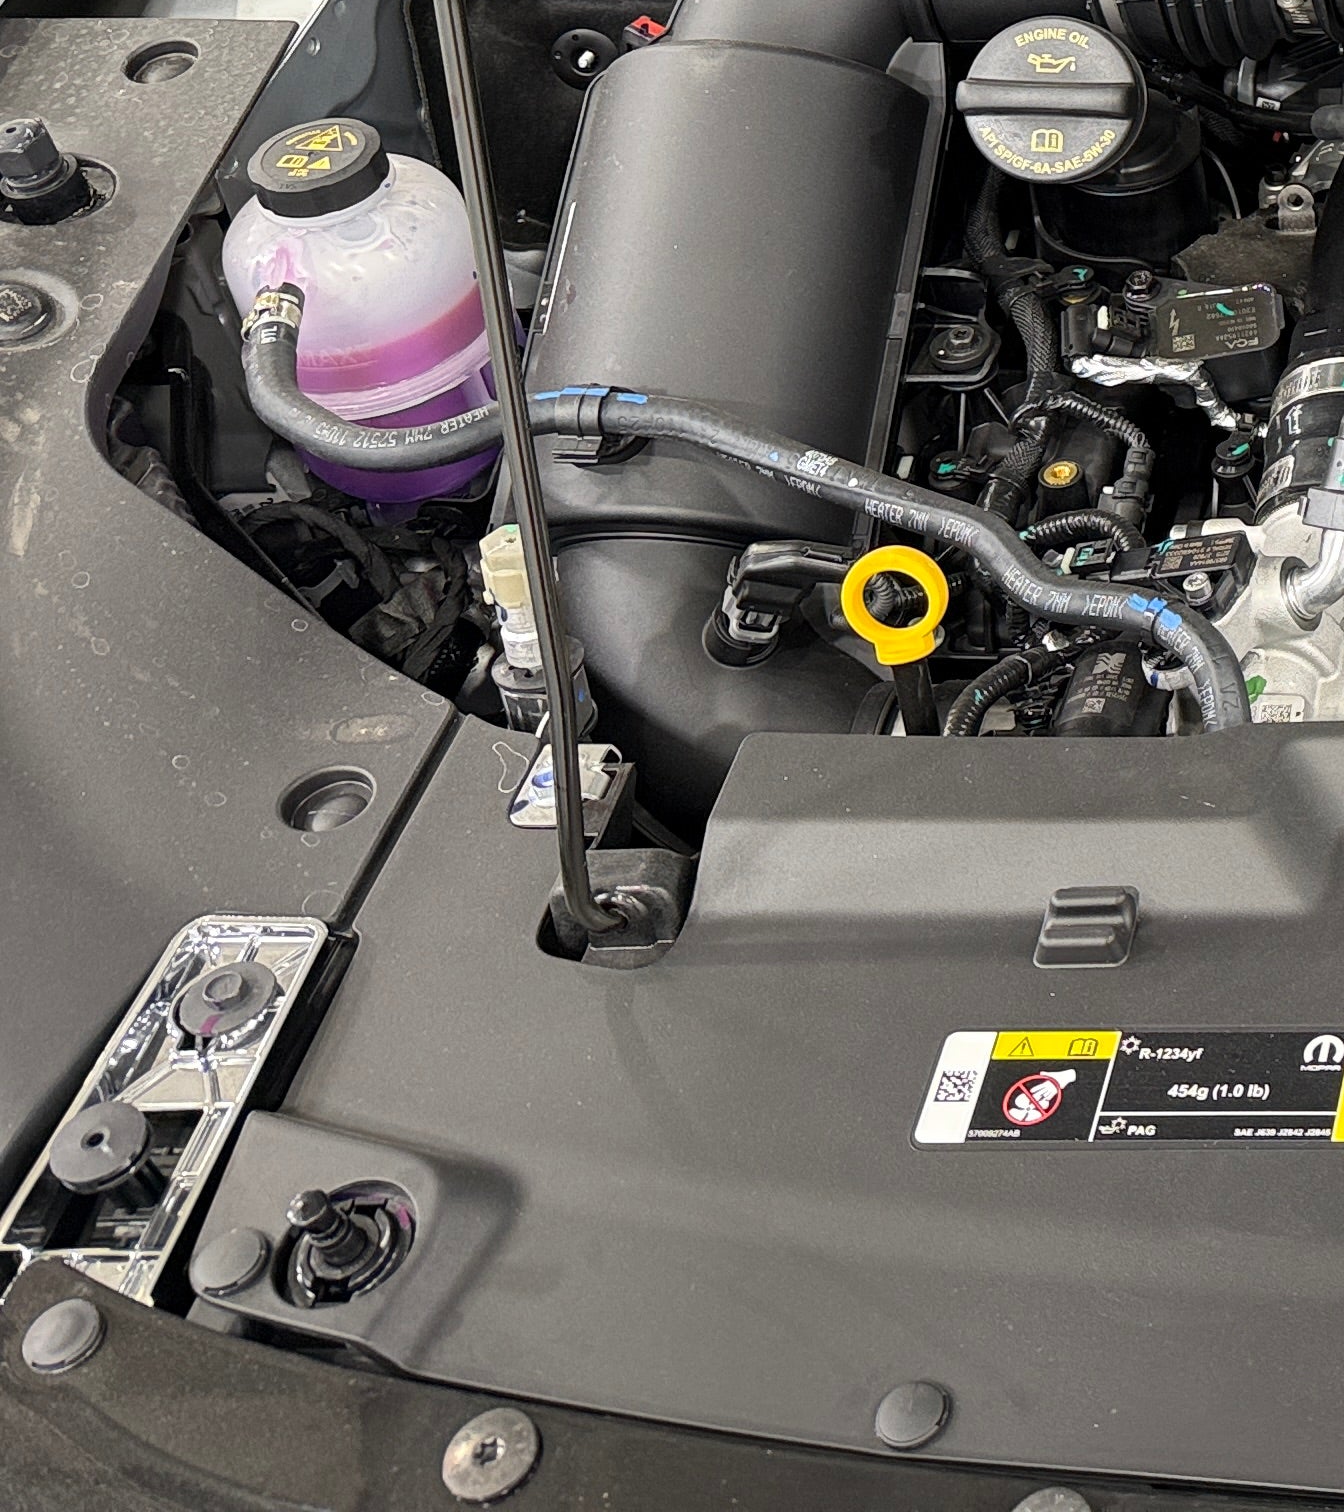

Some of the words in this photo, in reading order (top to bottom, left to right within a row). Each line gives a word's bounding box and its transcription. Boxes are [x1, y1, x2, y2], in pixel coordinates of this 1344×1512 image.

[1014, 28, 1067, 47] ENGINE
[1069, 32, 1089, 49] OIL
[979, 125, 996, 148] API
[993, 129, 1116, 175] SP/GF-6A-SAE-5W-30
[1225, 336, 1259, 349] FCA
[440, 405, 490, 434] HEATER
[864, 497, 904, 525] HEATER
[1002, 564, 1044, 606] HEATER
[1138, 1047, 1204, 1062] R-1234yf
[1299, 1064, 1342, 1072] MOPAR
[1167, 1084, 1209, 1101] 454g
[1212, 1083, 1245, 1101] (1.0
[1246, 1083, 1271, 1101] lb)
[1127, 1124, 1158, 1136] PAG
[1233, 1127, 1254, 1137] SAE
[1254, 1128, 1277, 1137] J639
